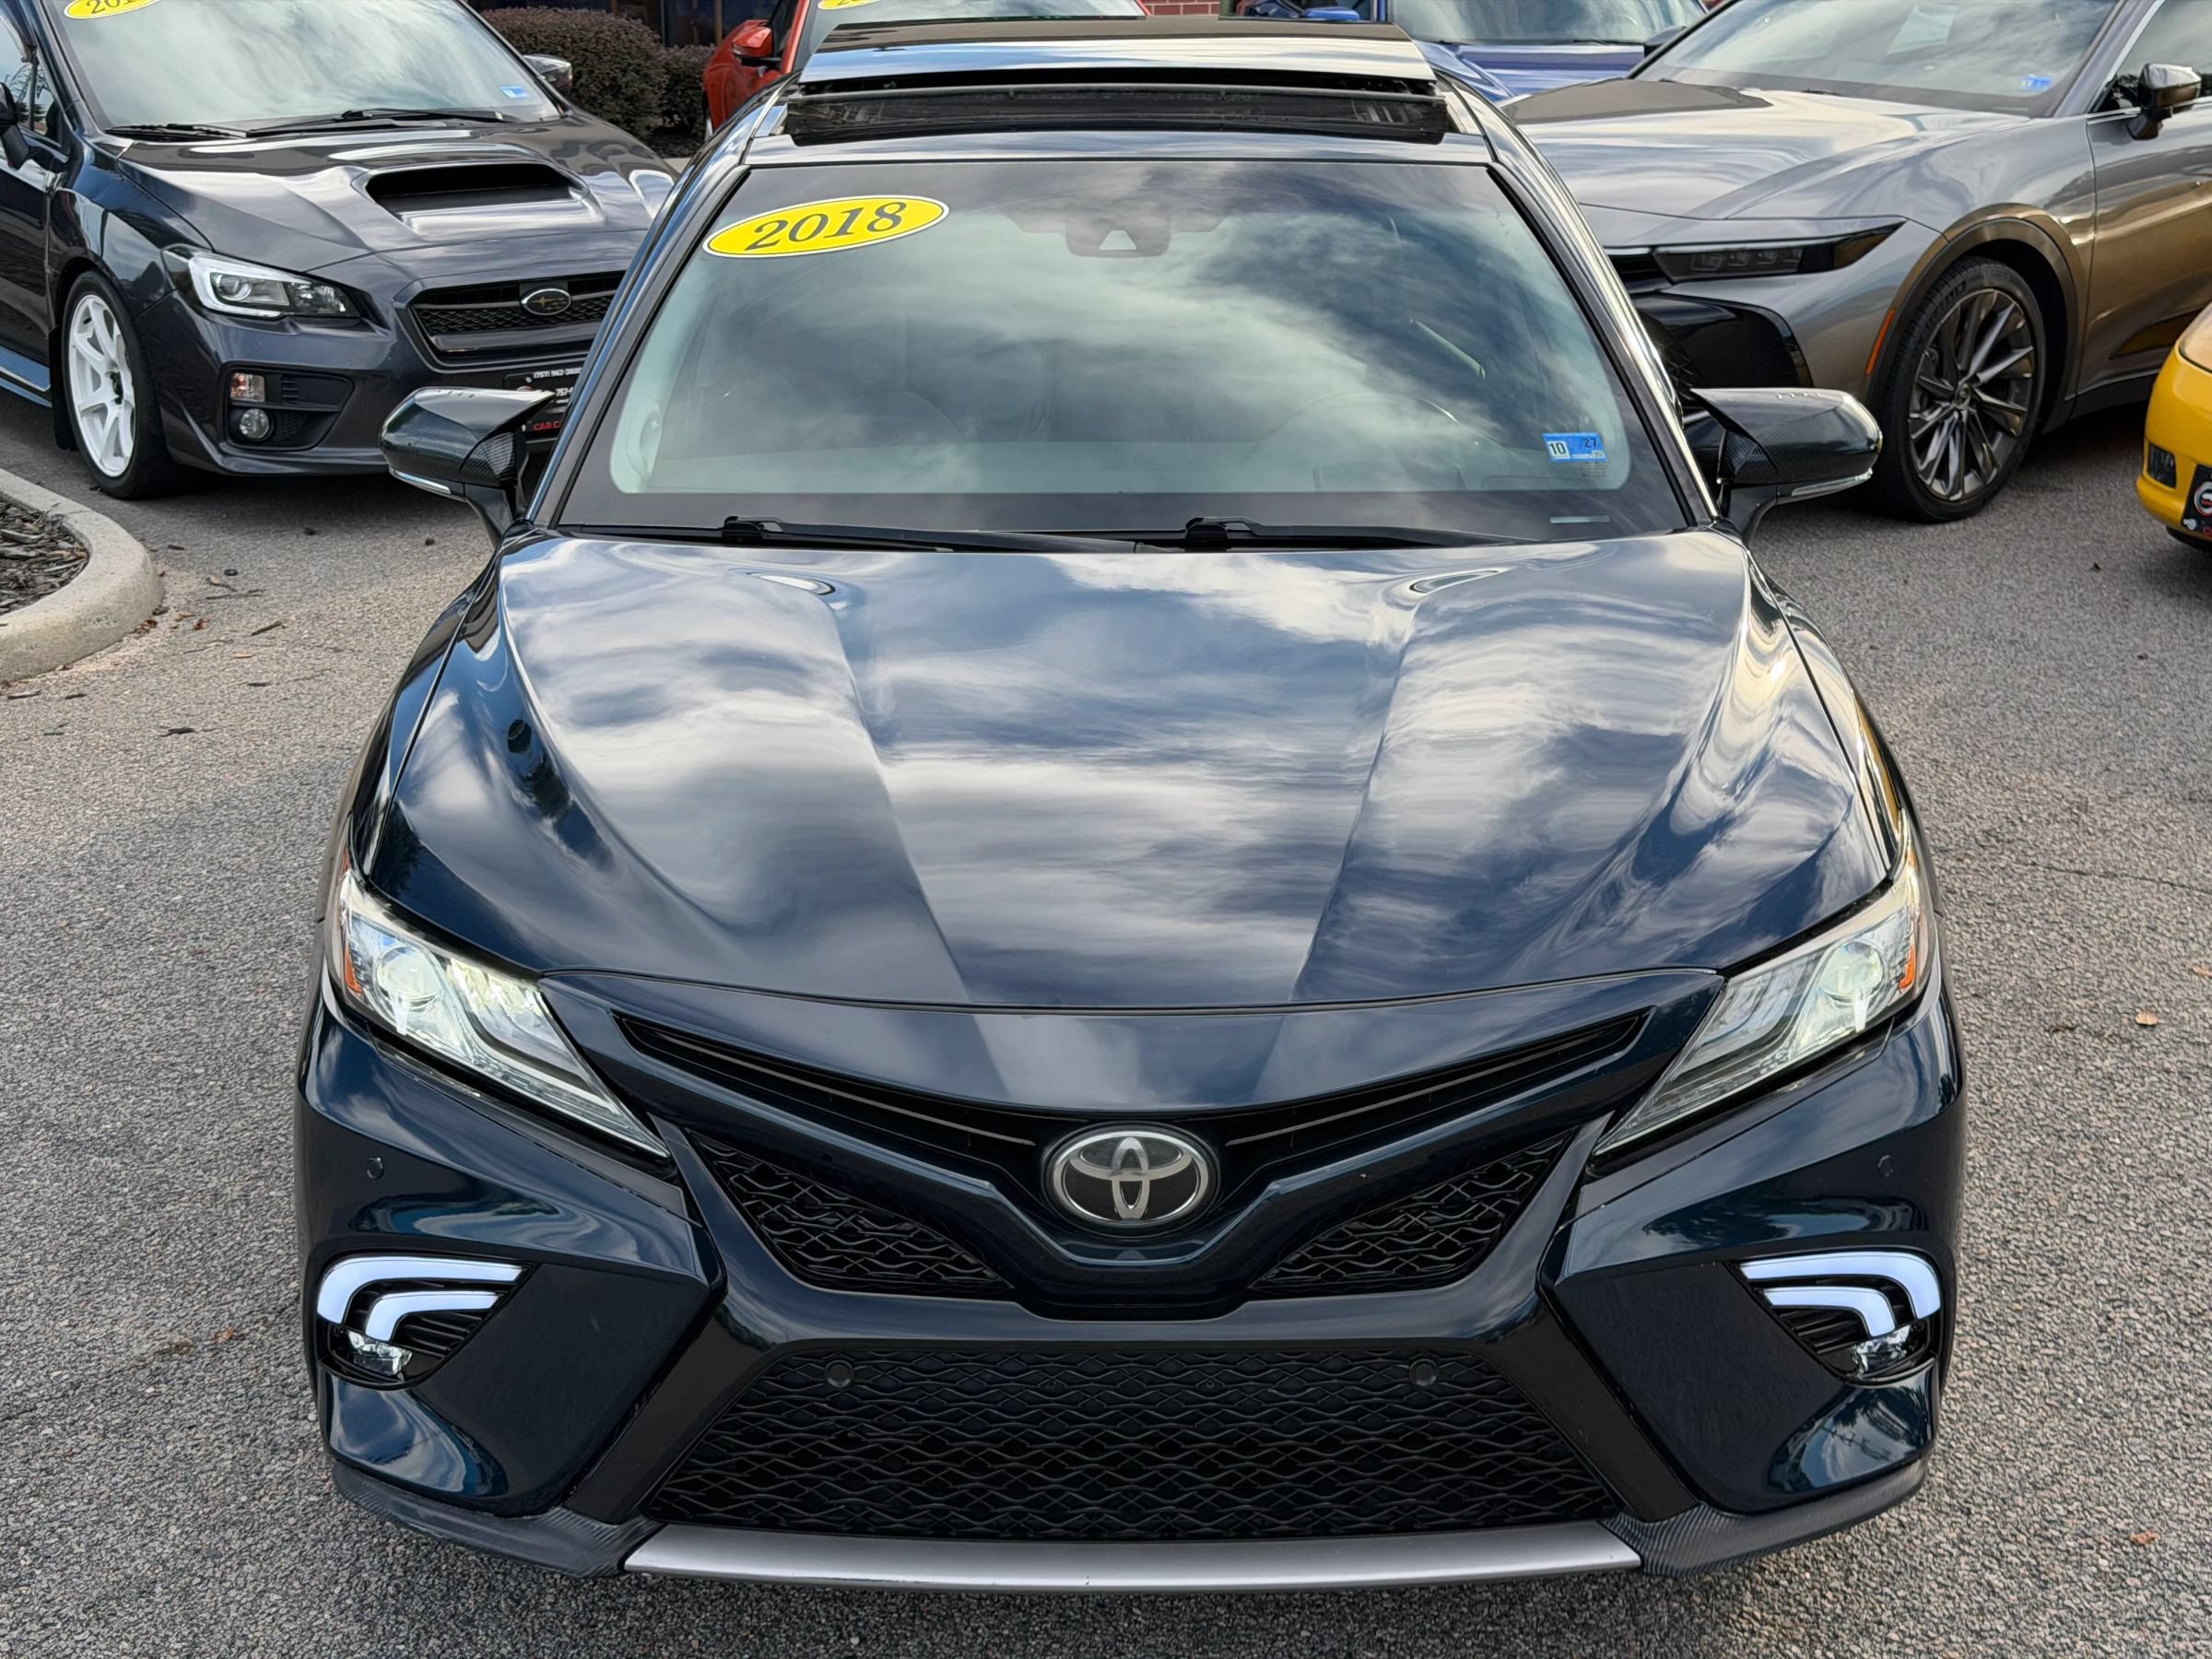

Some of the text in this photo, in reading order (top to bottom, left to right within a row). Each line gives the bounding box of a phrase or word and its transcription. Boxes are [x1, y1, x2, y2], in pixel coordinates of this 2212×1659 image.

[745, 202, 907, 251] 2018
[1548, 442, 1567, 455] 10
[1582, 436, 1597, 449] 27
